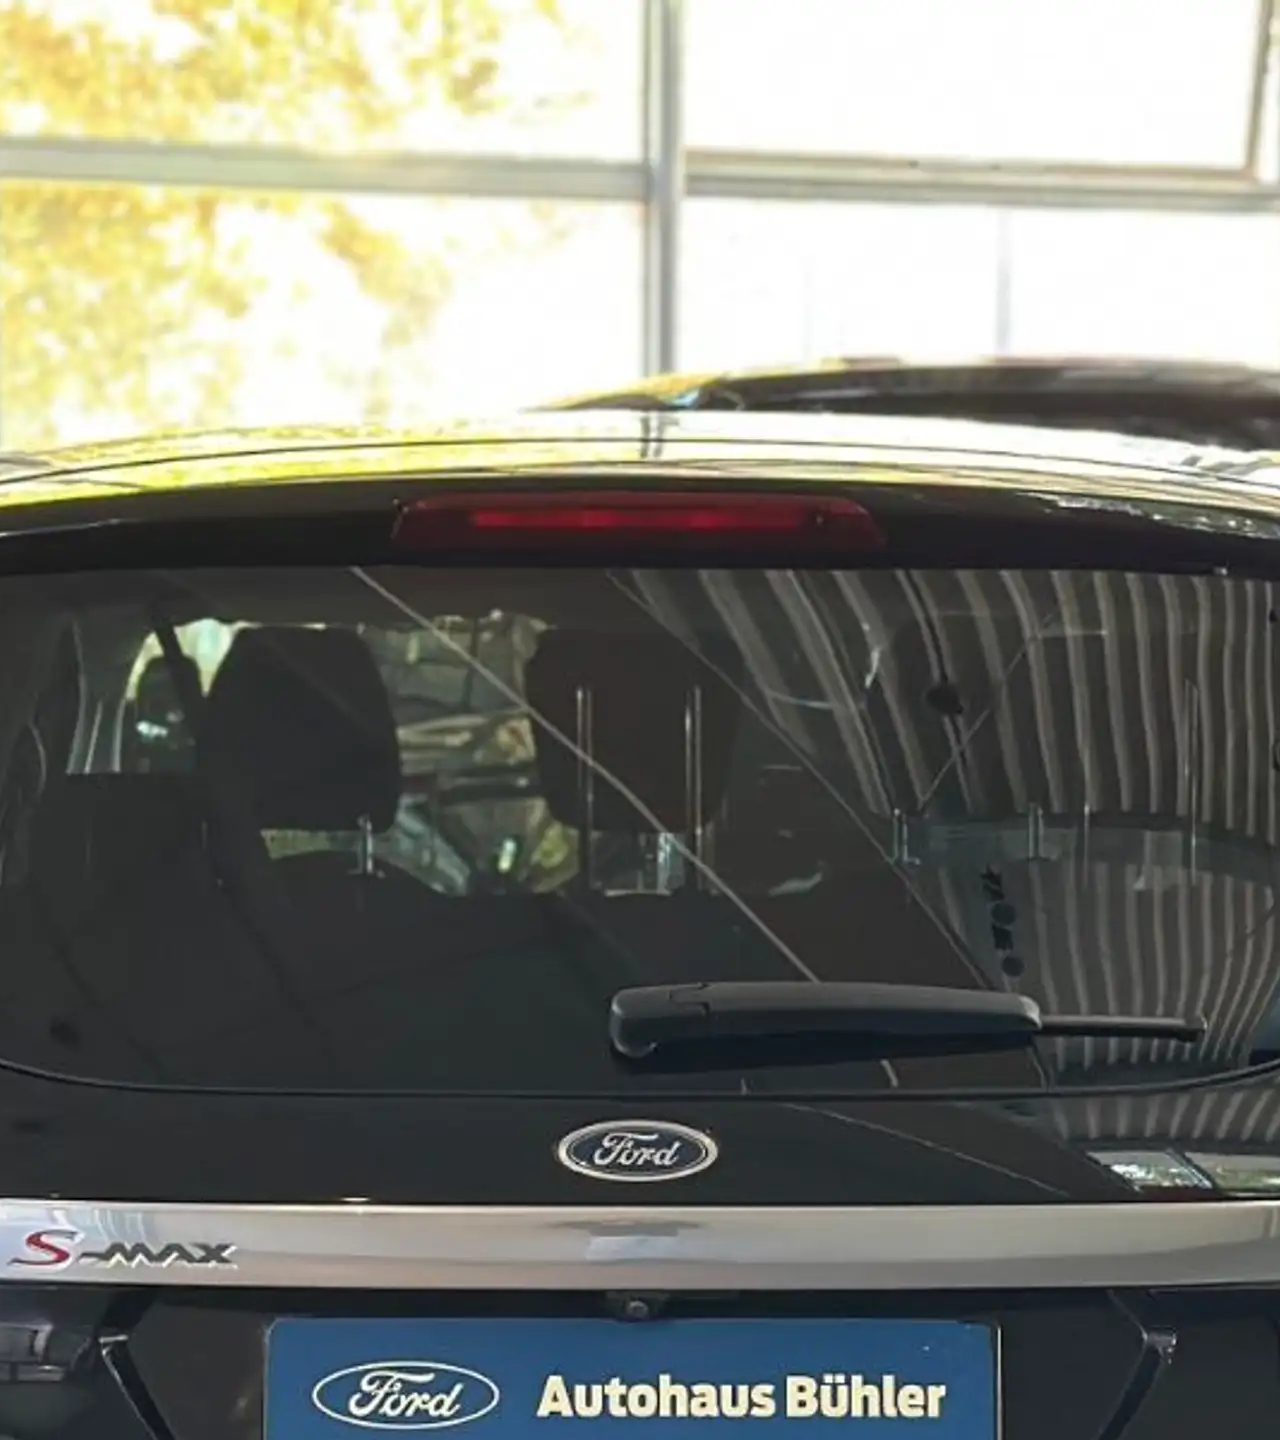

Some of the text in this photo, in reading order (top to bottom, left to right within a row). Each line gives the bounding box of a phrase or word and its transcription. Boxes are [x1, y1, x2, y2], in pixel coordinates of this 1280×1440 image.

[592, 1131, 682, 1166] Ford
[6, 1229, 238, 1268] S-MAX
[348, 1369, 465, 1418] Ford
[535, 1373, 947, 1418] Autohaus Bühler
